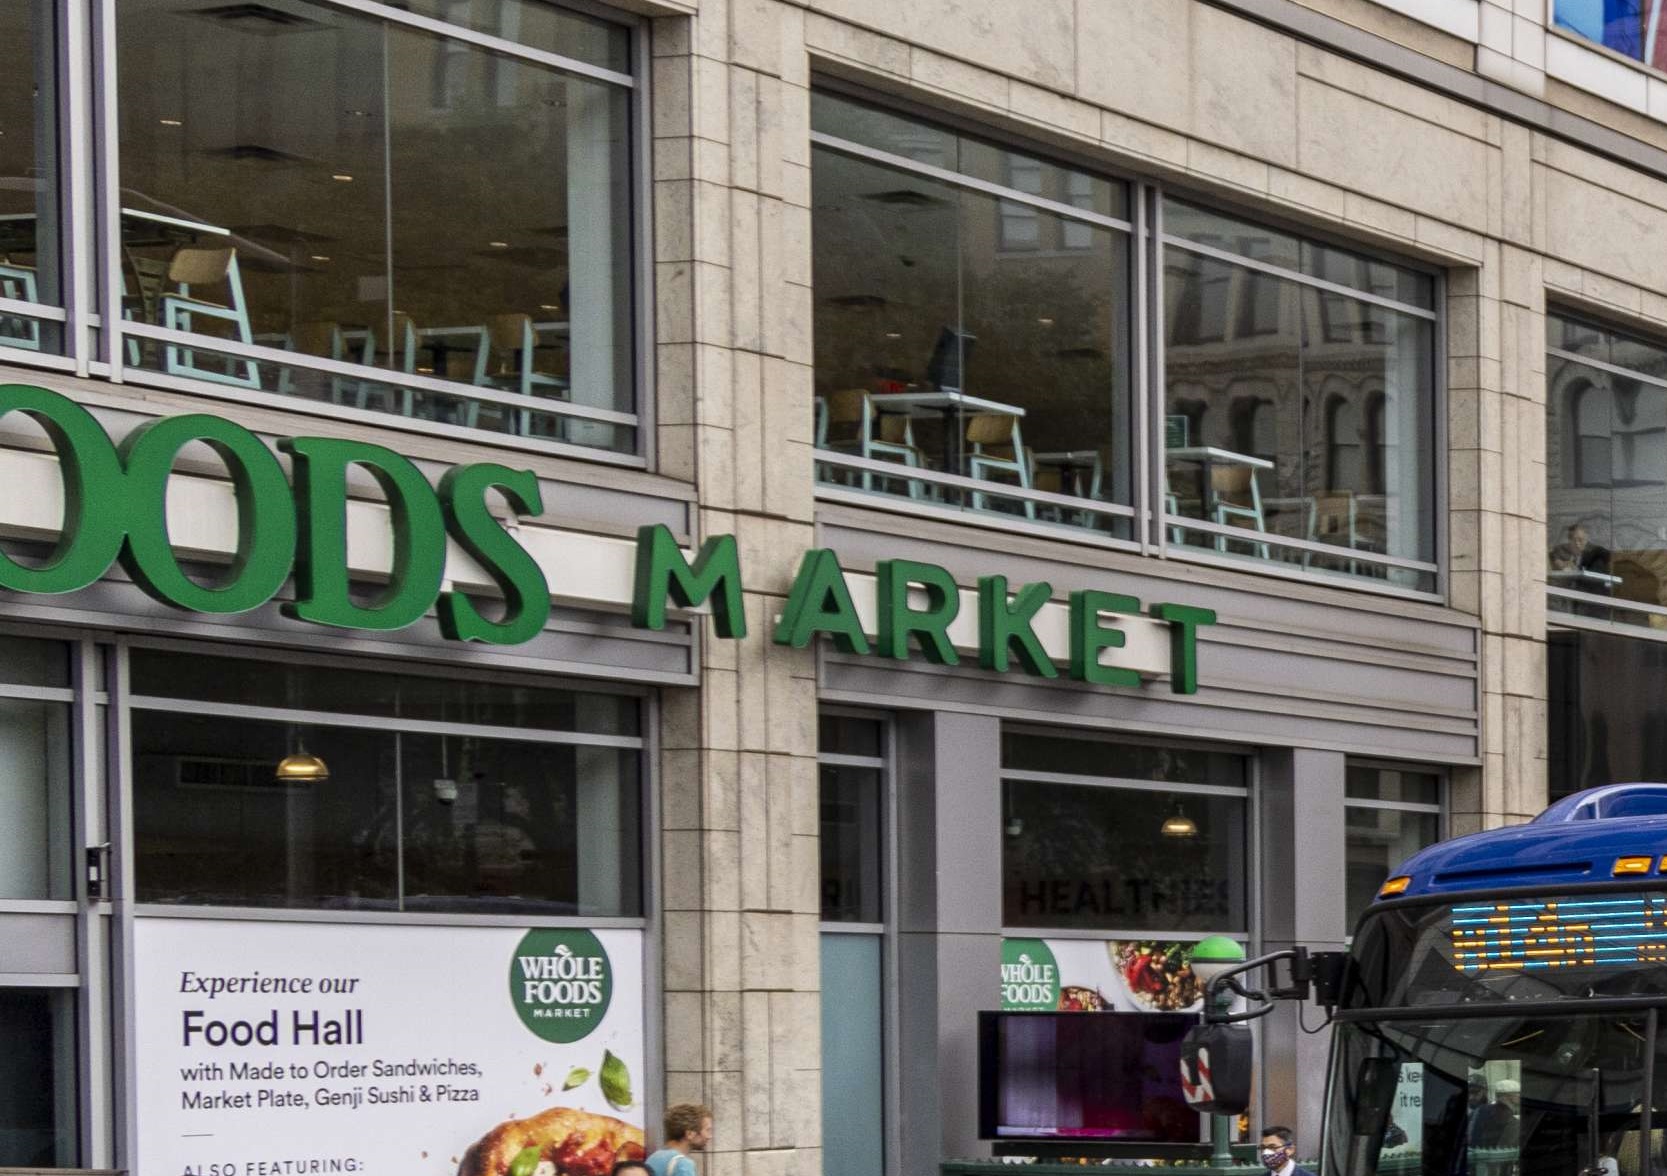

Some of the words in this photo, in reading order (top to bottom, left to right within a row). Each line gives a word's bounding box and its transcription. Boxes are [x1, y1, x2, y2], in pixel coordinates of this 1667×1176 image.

[631, 522, 1217, 695] MARKET
[518, 956, 604, 979] WHOLE
[179, 971, 313, 1000] Experience
[318, 976, 360, 994] our
[523, 981, 603, 1004] FOODS
[533, 1008, 591, 1018] MARKET
[182, 1009, 279, 1047] Food
[292, 1008, 363, 1045] Hall
[180, 1062, 224, 1082] with
[229, 1061, 285, 1080] Made
[290, 1063, 309, 1079] to
[313, 1059, 368, 1079] Order
[372, 1058, 483, 1078] Sandwiches,
[181, 1090, 253, 1110] Market
[258, 1089, 310, 1110] Plate,
[314, 1087, 364, 1109] Genji
[367, 1085, 415, 1105] Sushi
[418, 1085, 432, 1103] &
[436, 1084, 480, 1103] Pizza
[246, 1157, 365, 1176] FEATURING:
